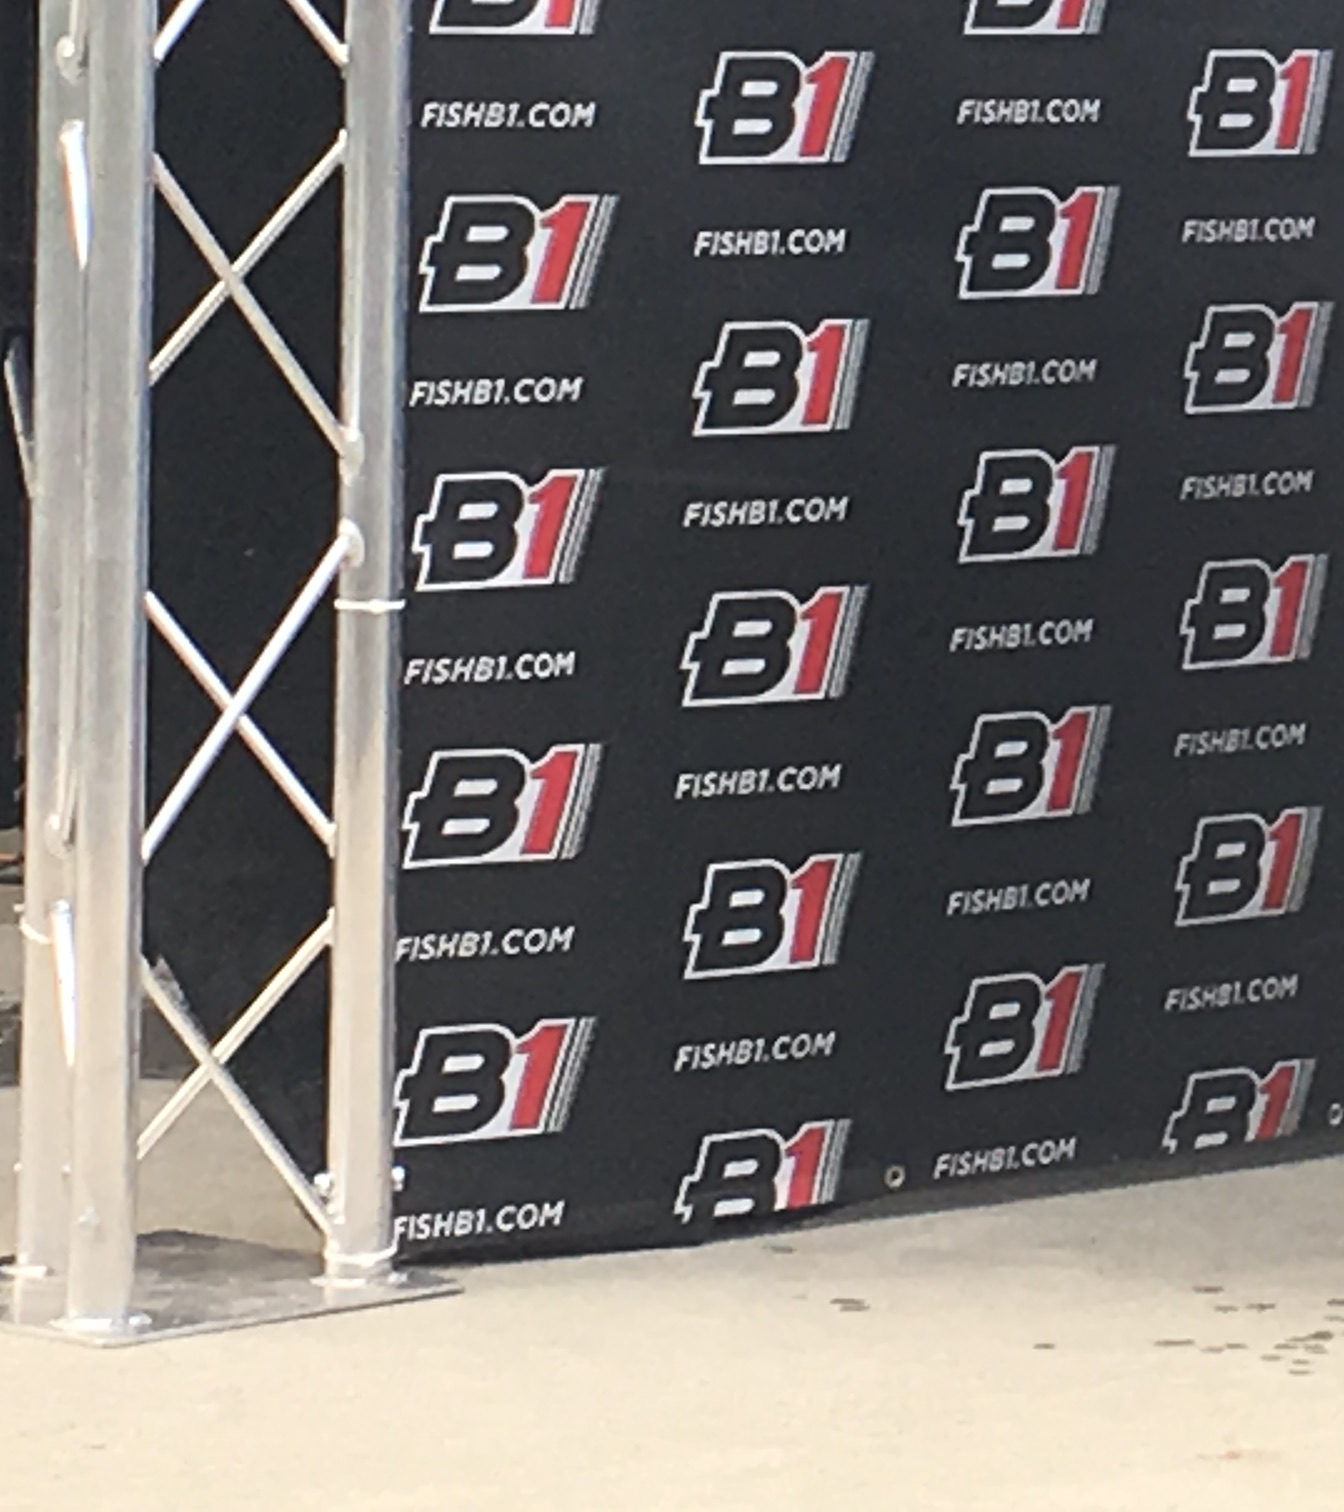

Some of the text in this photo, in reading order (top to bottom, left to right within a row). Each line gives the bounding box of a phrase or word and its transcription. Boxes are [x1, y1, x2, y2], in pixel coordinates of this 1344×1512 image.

[423, 102, 596, 127] FISHB1.COM
[694, 51, 874, 165] B1
[957, 99, 1100, 124] FISHB1.COM
[1187, 49, 1333, 157] B1
[694, 229, 846, 257] FISHB1.COM
[955, 186, 1119, 299] B1
[1182, 217, 1315, 242] FISHB1.COM
[420, 194, 619, 312] B1
[692, 319, 869, 437] B1
[952, 359, 1097, 387] FISHB1.COM
[1184, 301, 1333, 414] B1
[411, 377, 584, 404] FISHB1.COM
[957, 445, 1115, 564] B1
[1180, 470, 1313, 499] FISHB1.COM
[413, 468, 605, 590] B1
[683, 496, 848, 527] FISHB1.COM
[1180, 554, 1327, 670] B1
[680, 585, 868, 707] B1
[950, 619, 1093, 652] FISHB1.COM
[403, 651, 575, 682] FISHB1.COM
[1175, 723, 1305, 756] FISHB1.COM
[675, 764, 841, 799] FISHB1.COM
[950, 706, 1111, 827] B1
[402, 743, 604, 870] B1
[1175, 807, 1322, 927] B1
[683, 853, 861, 980] B1
[947, 879, 1090, 915] FISHB1.COM
[395, 925, 575, 964] FISHB1.COM
[1165, 975, 1297, 1010] FISHB1.COM
[944, 964, 1104, 1091] B1
[674, 1031, 835, 1071] FISHB1.COM
[394, 1017, 596, 1146] B1
[935, 1138, 1075, 1177] FISHB1.COM
[390, 1200, 565, 1248] FISHB1.COM
